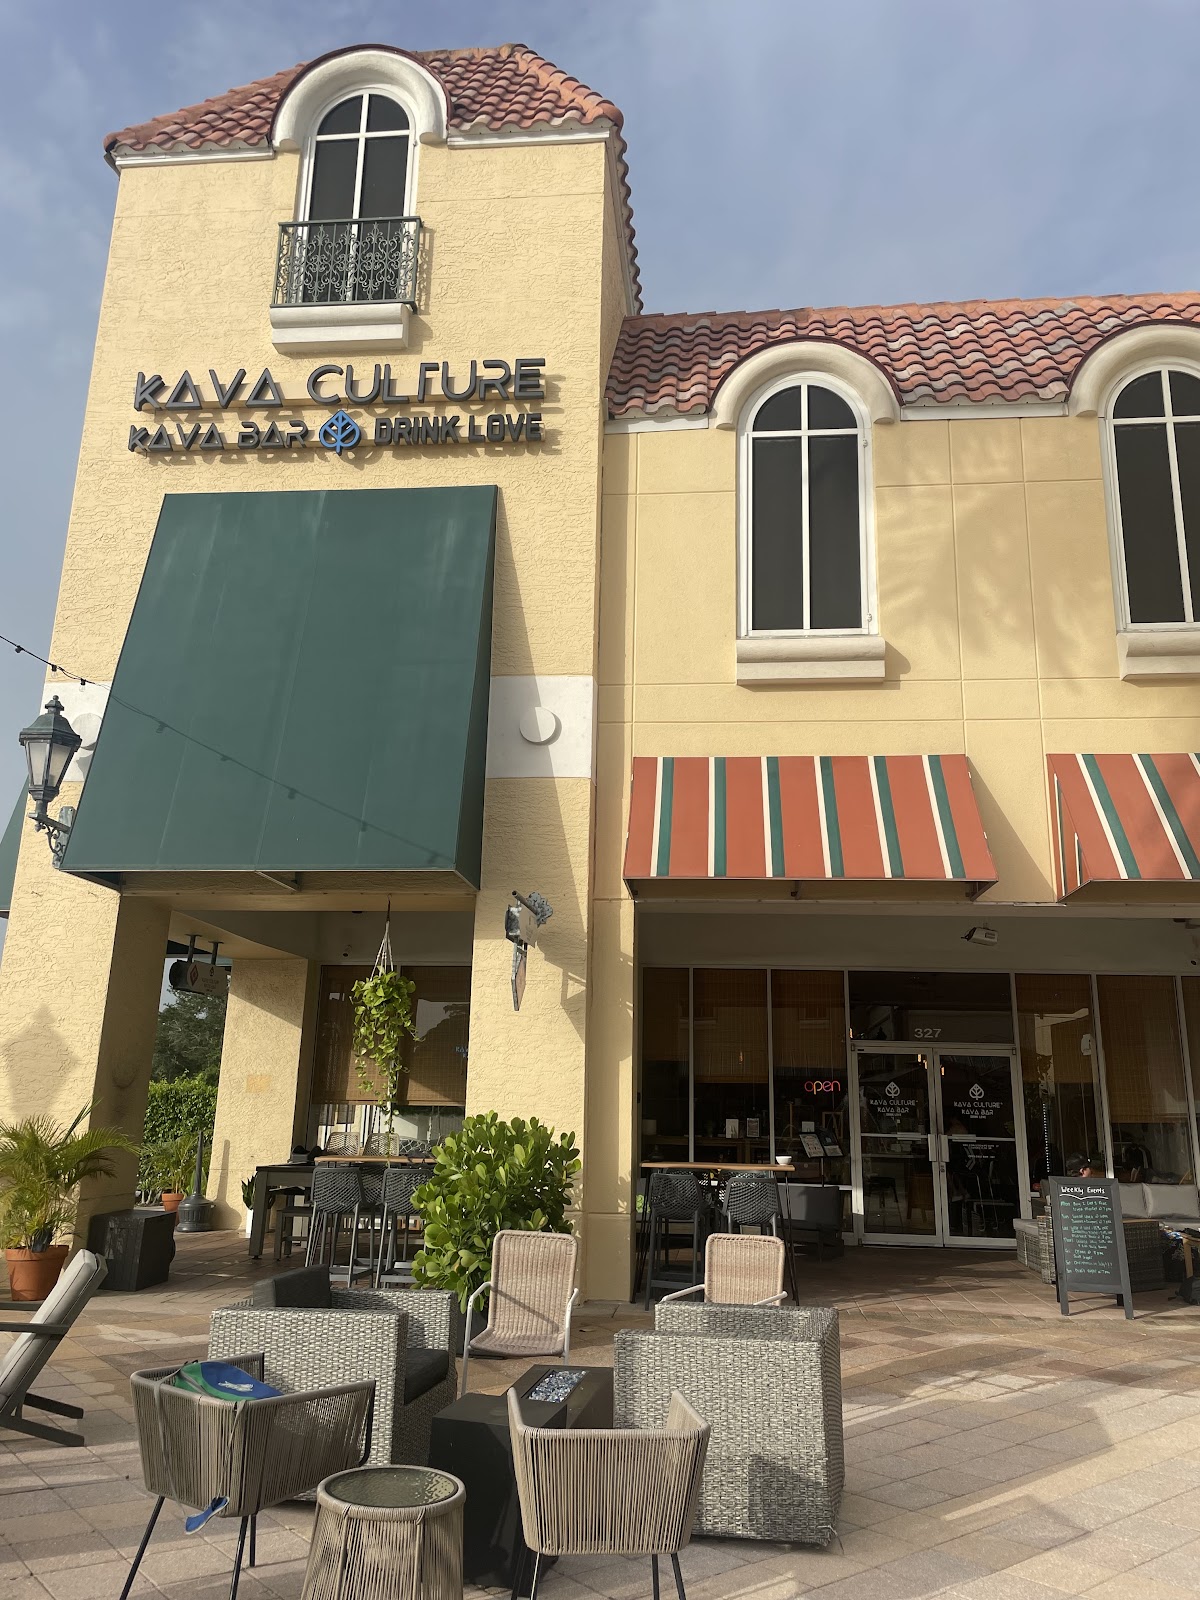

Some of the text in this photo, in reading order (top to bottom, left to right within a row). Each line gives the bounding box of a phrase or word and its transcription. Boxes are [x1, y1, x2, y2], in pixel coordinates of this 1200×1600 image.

[134, 358, 545, 411] KAVA CULTURE
[128, 413, 542, 452] KAVA BAR DRINK LOVE
[914, 1028, 942, 1039] 327
[804, 1080, 841, 1095] open
[973, 1101, 1001, 1109] CULTURE
[1060, 1186, 1106, 1195] Weekly Events
